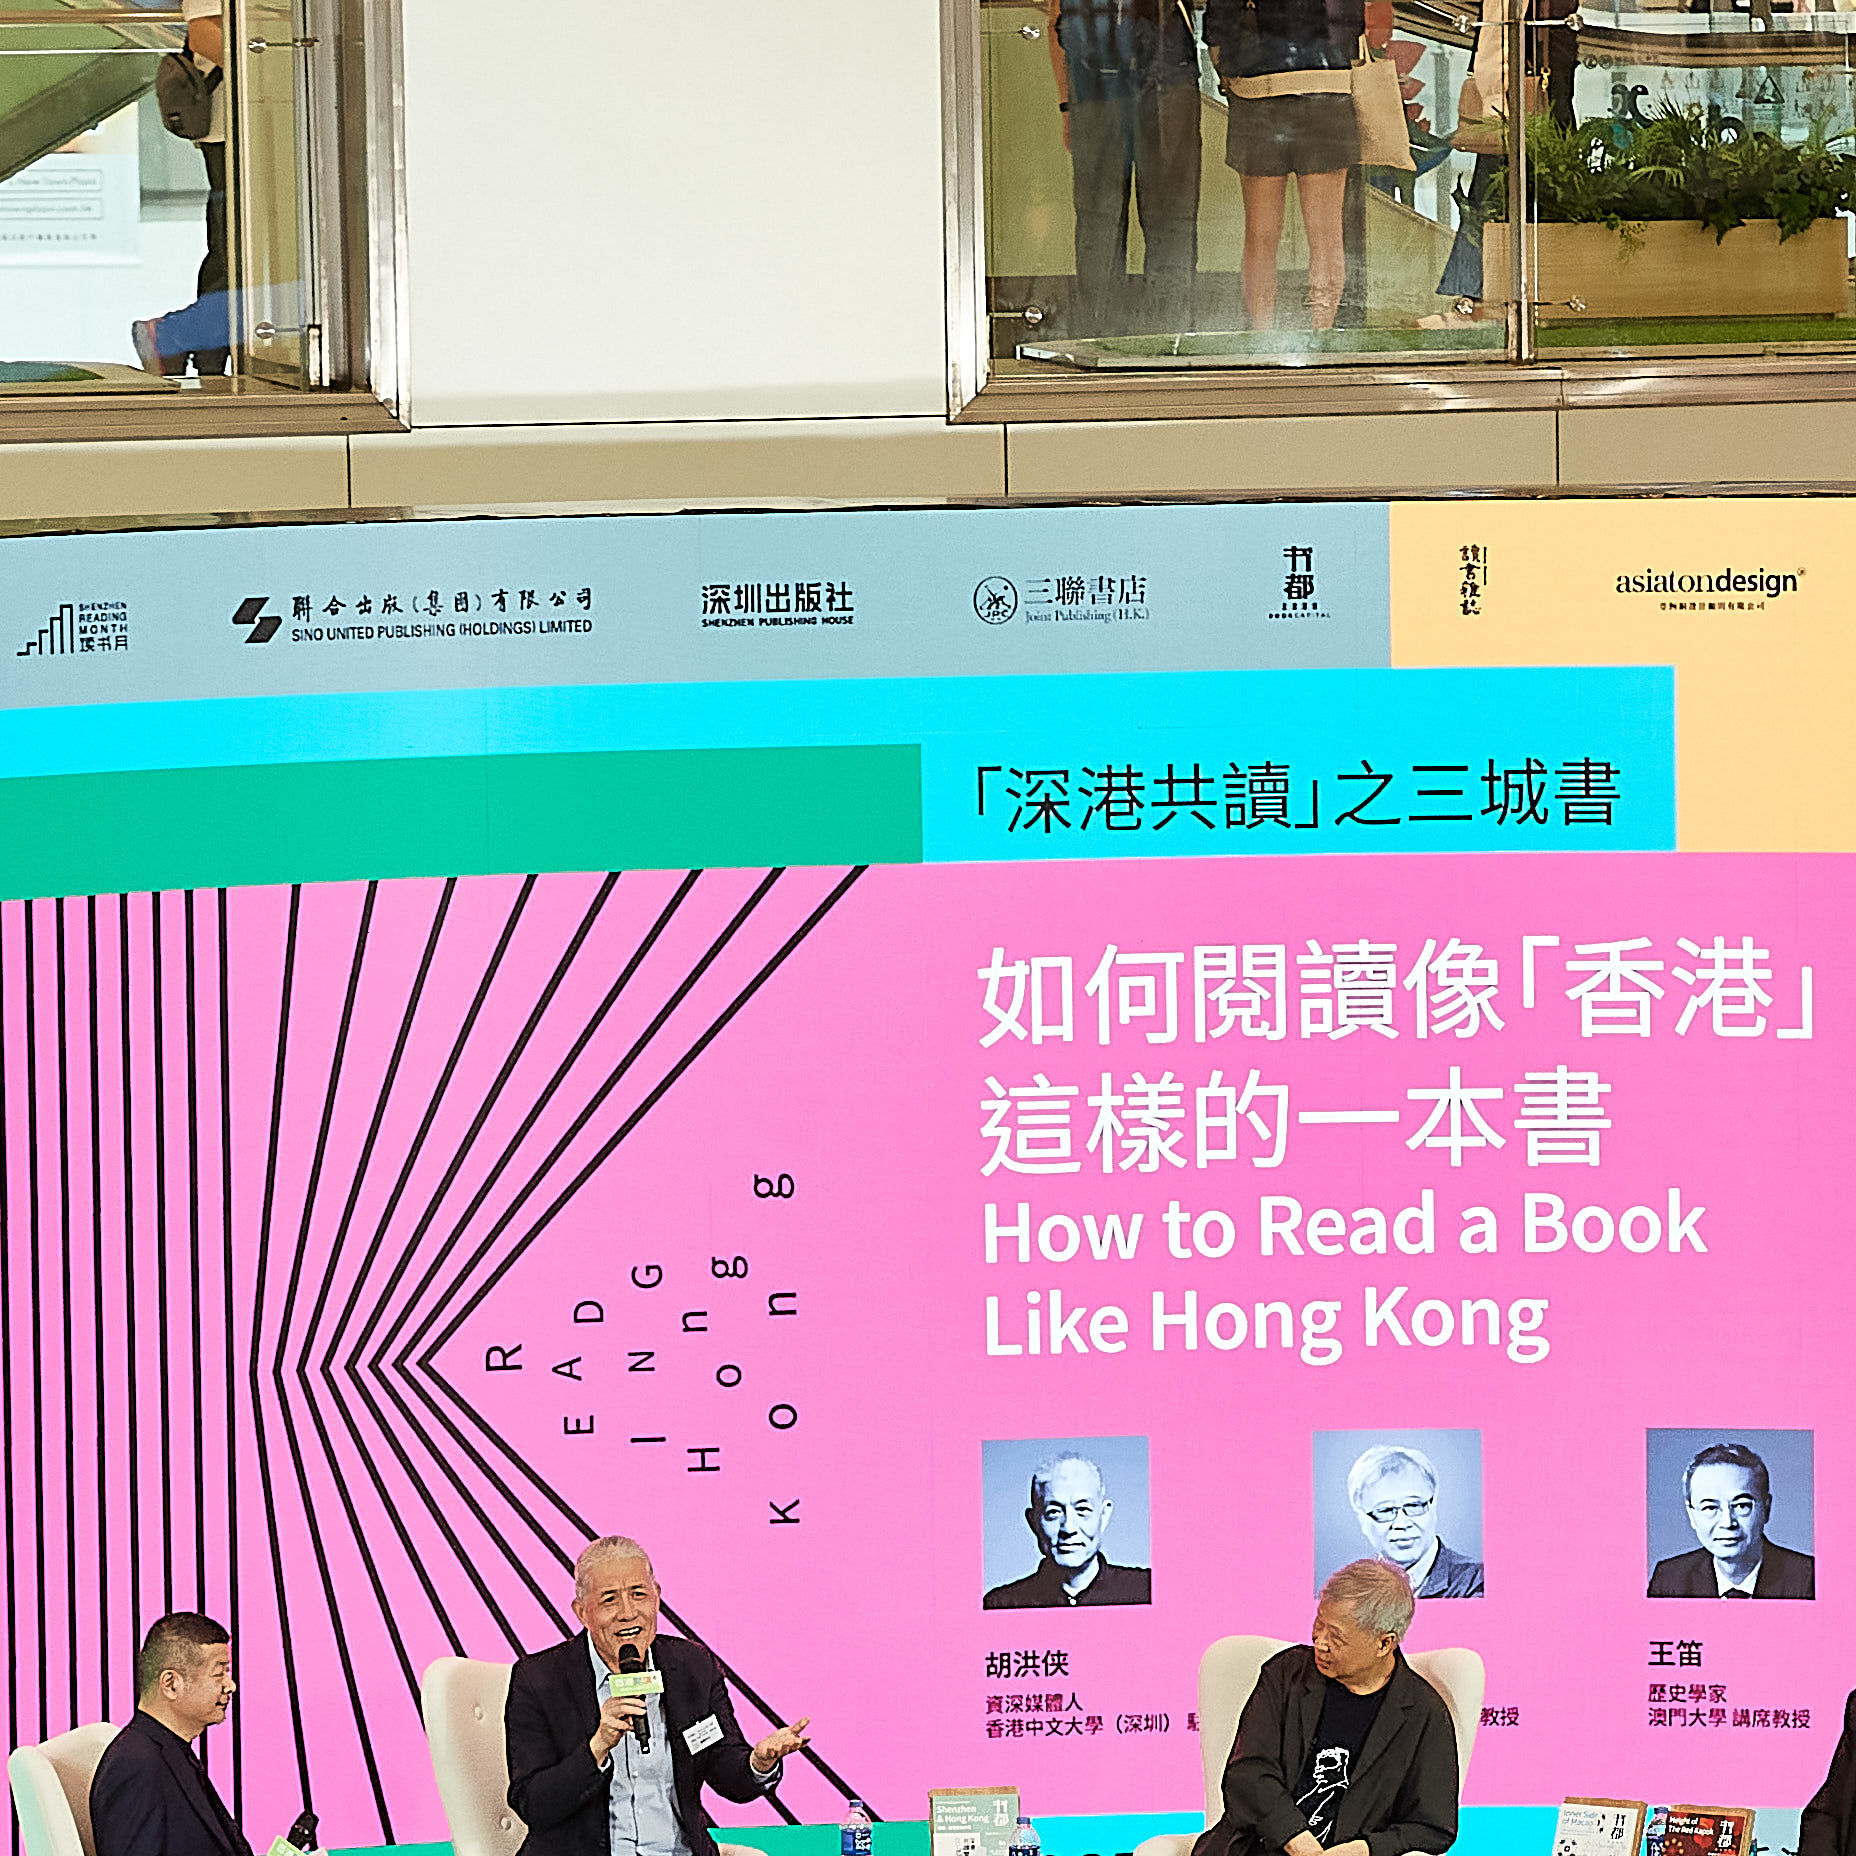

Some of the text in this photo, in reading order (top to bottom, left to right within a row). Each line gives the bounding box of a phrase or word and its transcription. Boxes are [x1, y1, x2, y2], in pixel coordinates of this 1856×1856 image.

[701, 581, 856, 616] 深圳出版社
[1024, 575, 1147, 606] 三聯書店
[78, 612, 128, 623] READING
[78, 624, 129, 635] MONTH
[291, 618, 593, 643] SINO UNITED PUBLISHING (HOLDINGS) LIMITED
[975, 757, 1624, 835] 「深港共讀」之三城書
[976, 935, 1816, 1047] 如何閱讀像「香港」
[979, 1064, 1615, 1177] 這樣的一本書
[984, 1186, 1710, 1264] How to Read a Book
[985, 1284, 1552, 1367] Like Hong Kong
[985, 1649, 1070, 1680] 胡洪侠
[1647, 1640, 1704, 1669] 王笛
[985, 1692, 1084, 1715] 資深媒體人
[1647, 1683, 1728, 1704] 歷史學家
[1647, 1707, 1812, 1730] 澳門大學 講席教授
